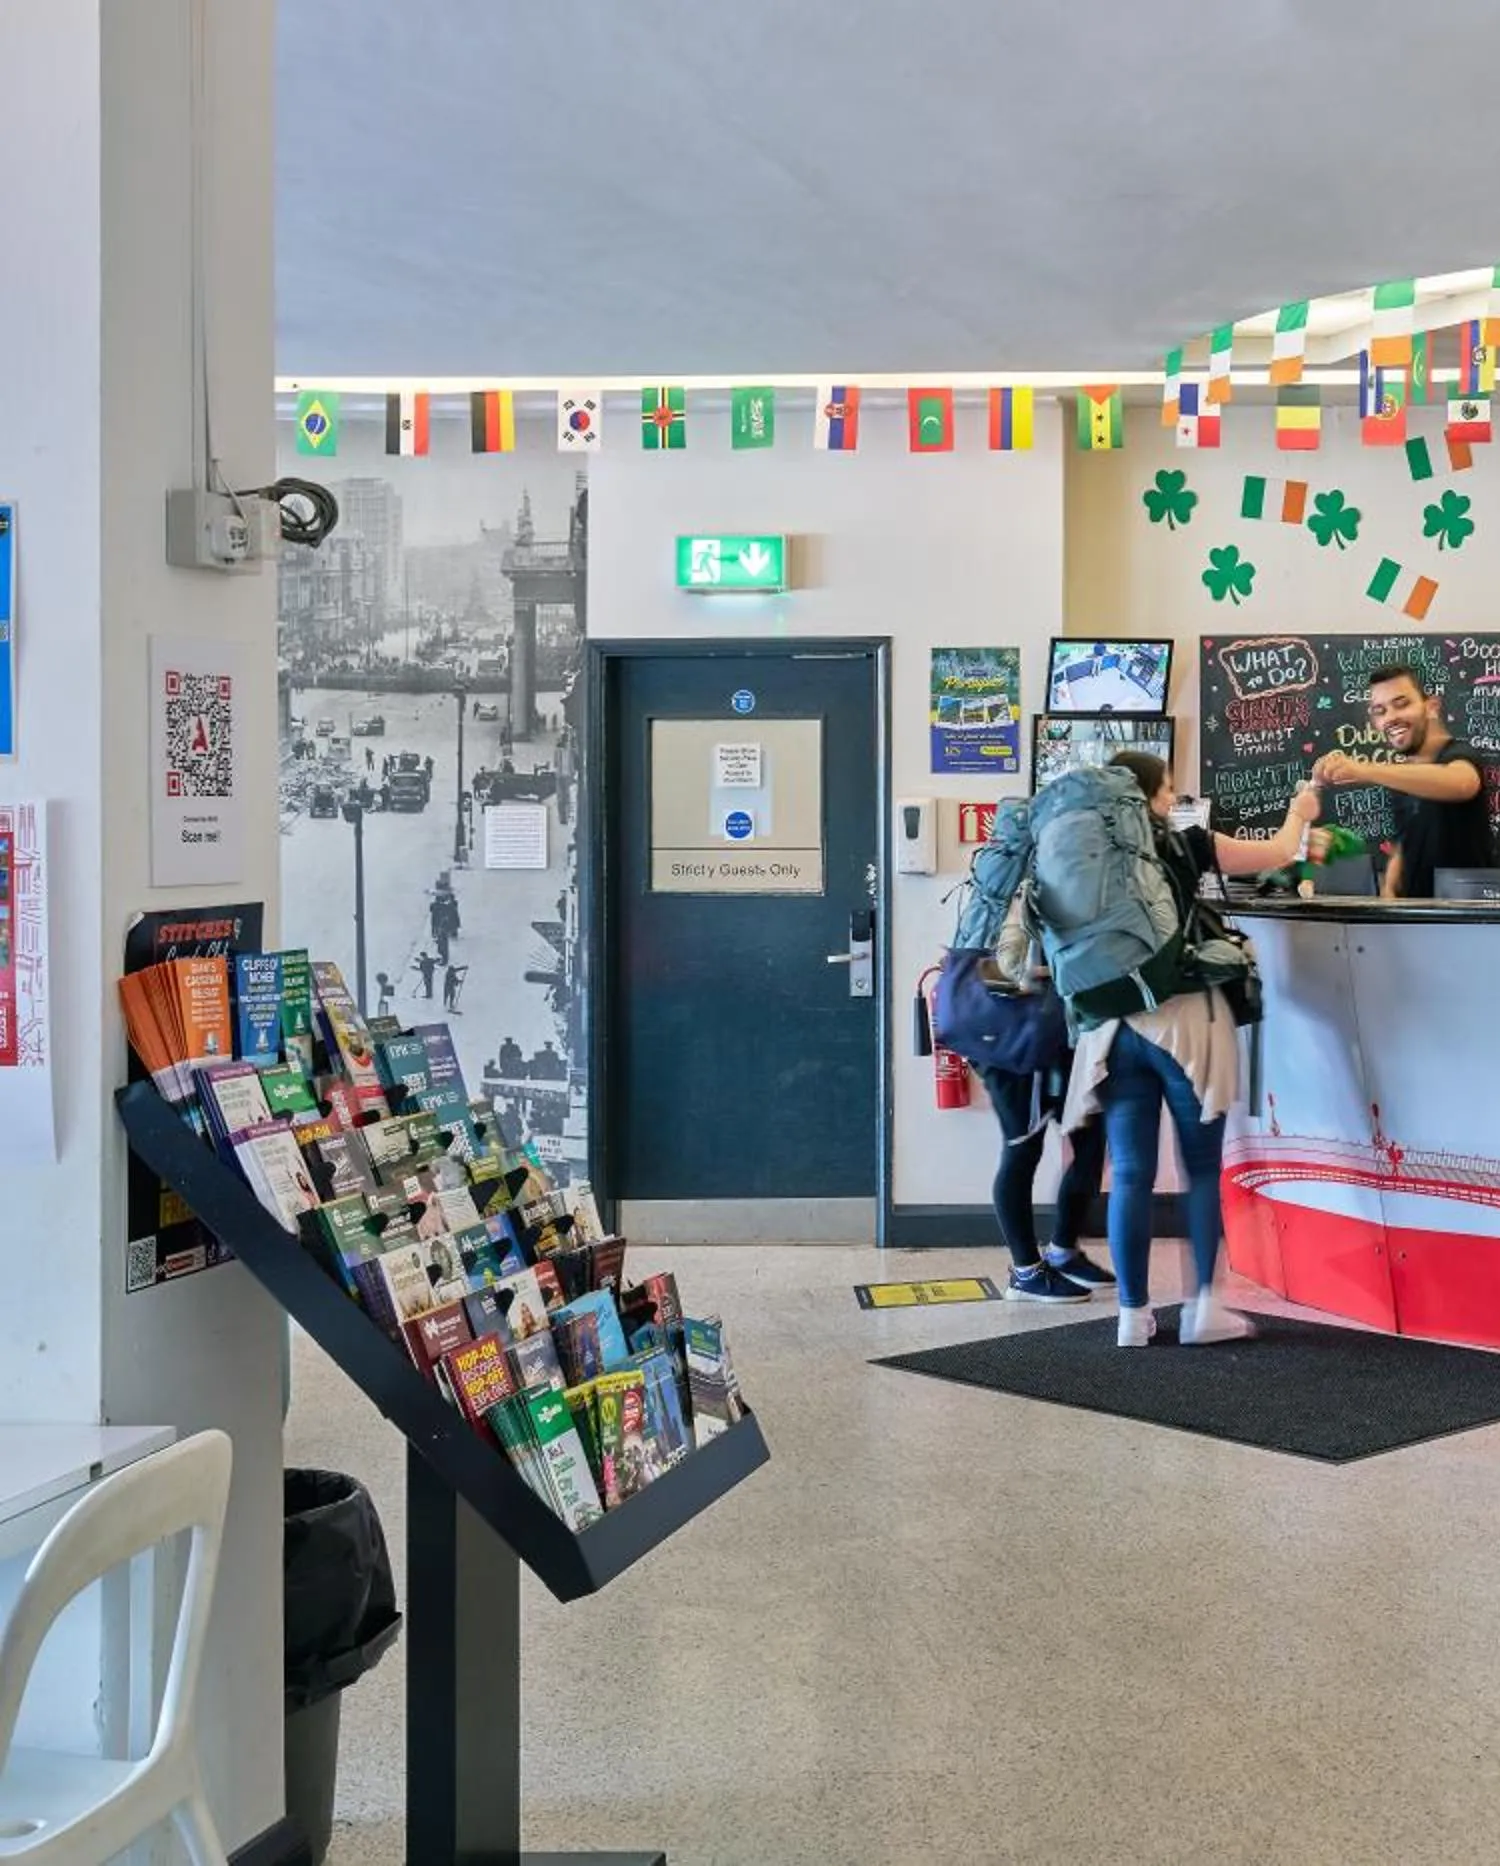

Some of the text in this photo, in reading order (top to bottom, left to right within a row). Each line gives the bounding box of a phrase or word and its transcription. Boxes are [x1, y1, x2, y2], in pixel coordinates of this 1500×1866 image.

[1363, 637, 1425, 649] KILKENNY
[1229, 643, 1296, 674] WHAT
[1233, 727, 1295, 747] BELFAST
[181, 829, 202, 843] Scan
[671, 863, 801, 879] Strictly Guests Only
[456, 1341, 498, 1369] HOP-ON
